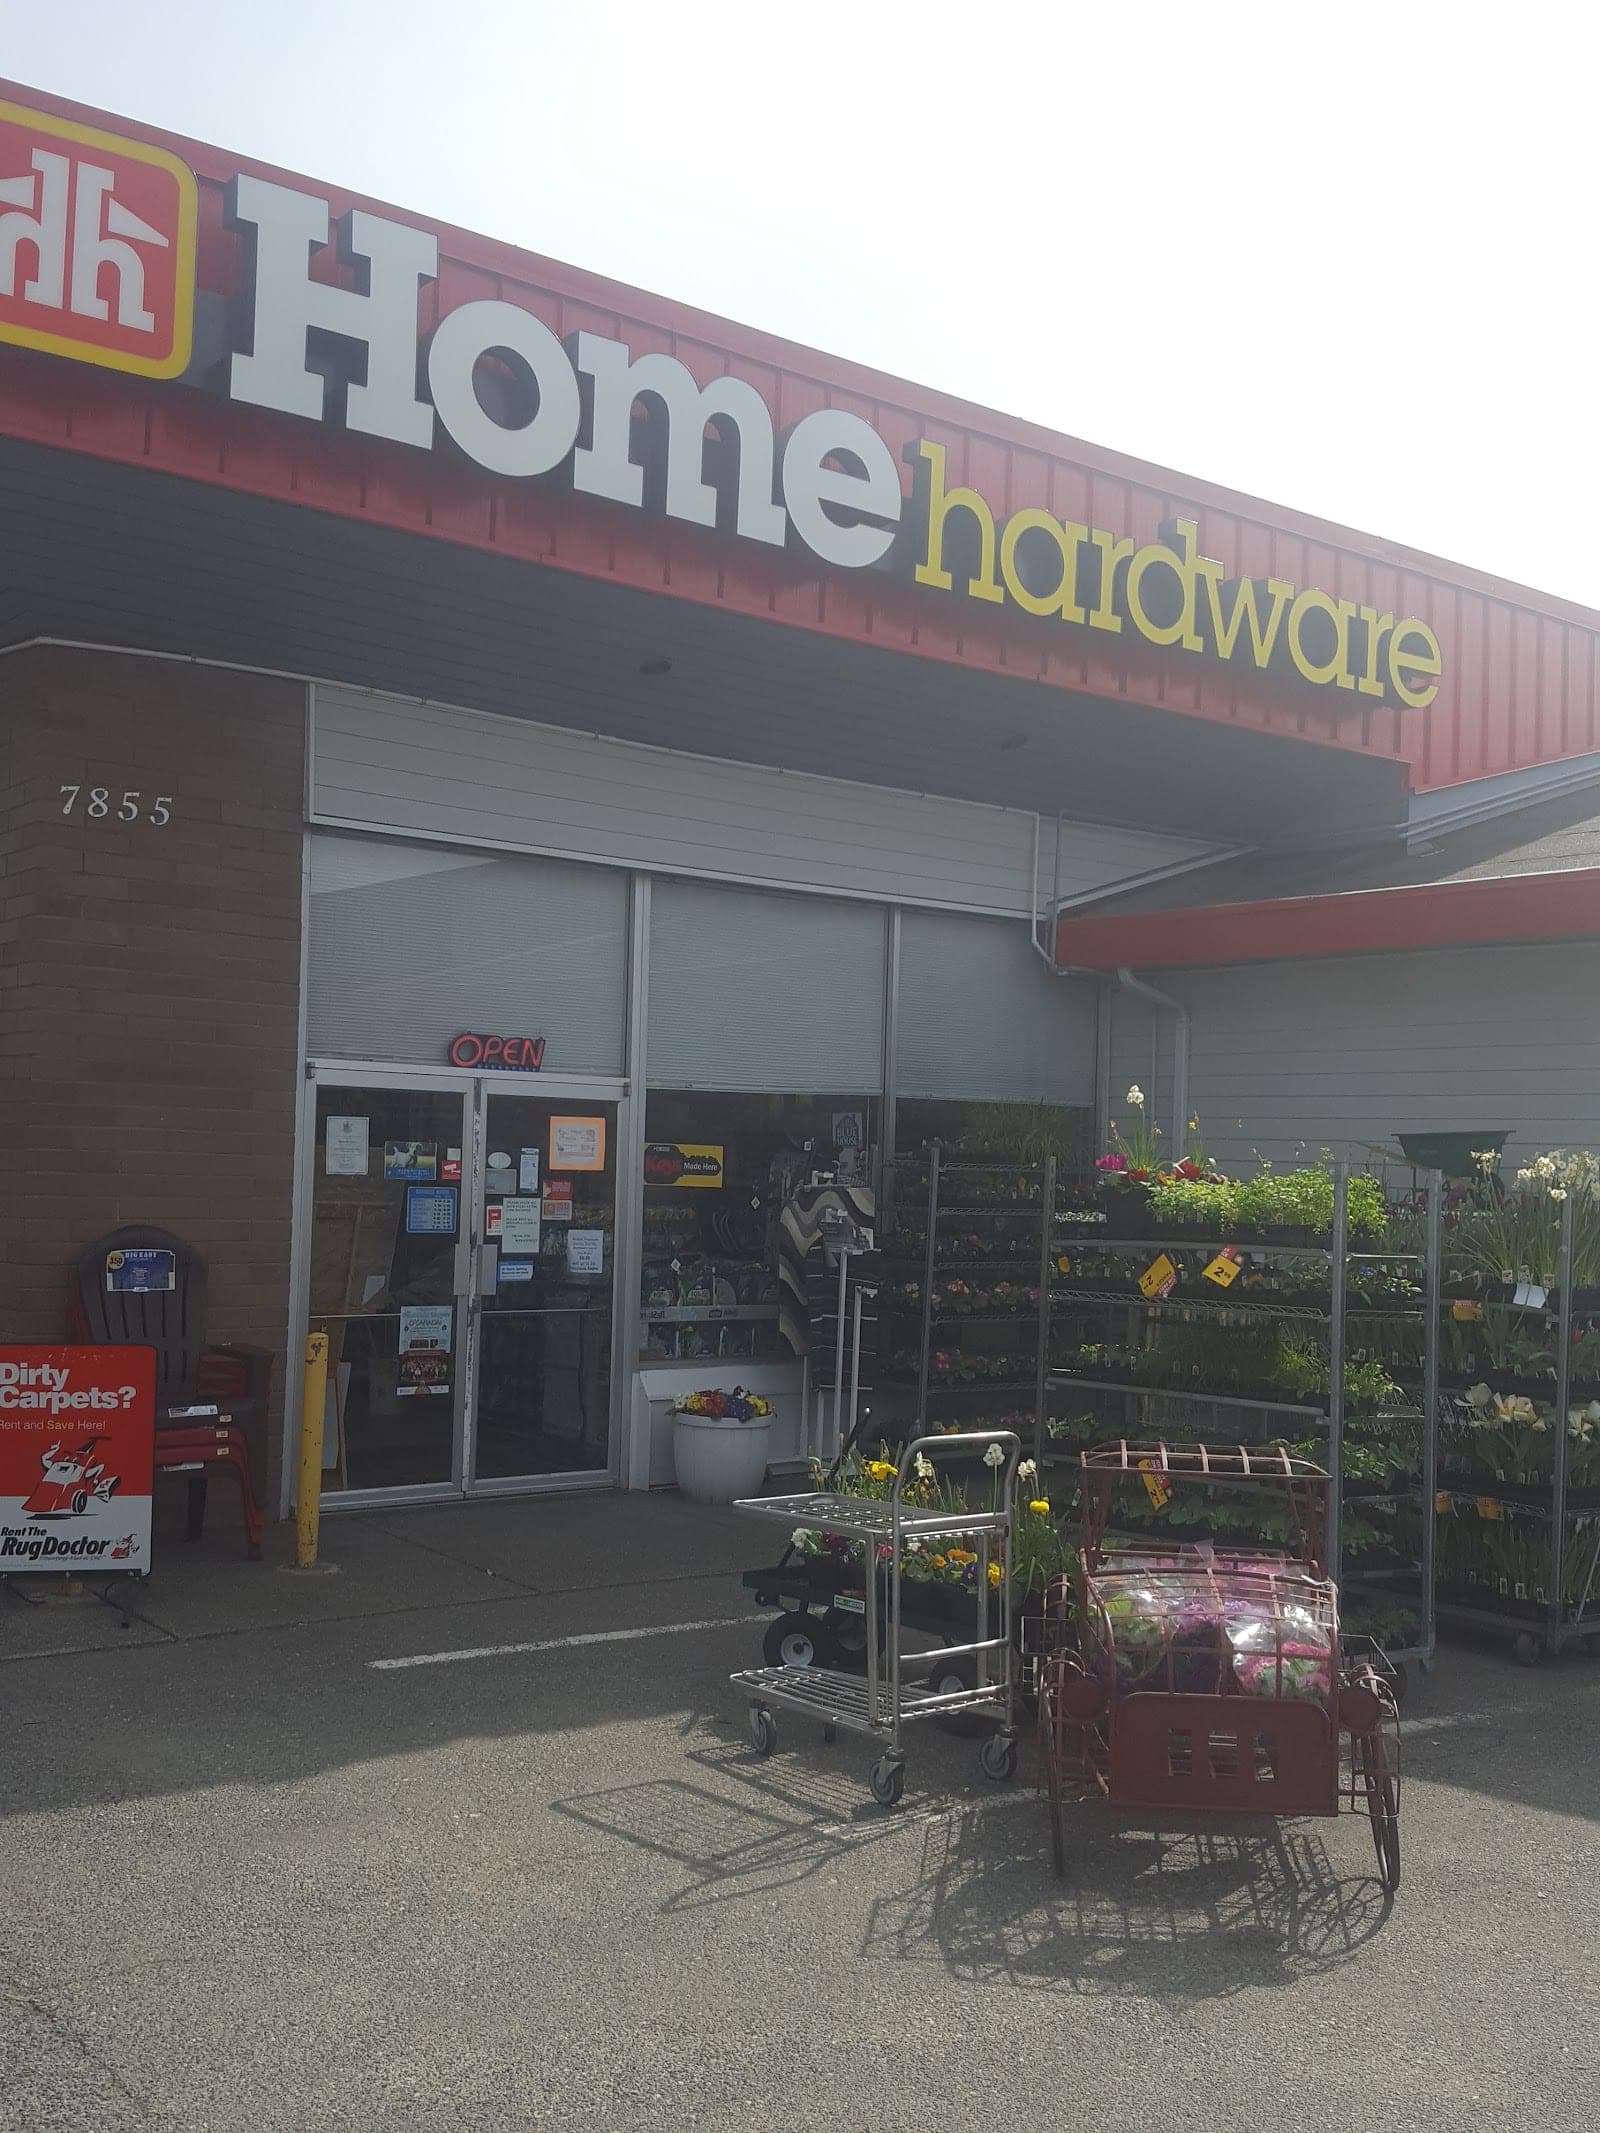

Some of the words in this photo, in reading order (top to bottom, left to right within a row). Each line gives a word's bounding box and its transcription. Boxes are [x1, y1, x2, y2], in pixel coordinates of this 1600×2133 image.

[229, 172, 903, 568] Home
[914, 438, 1443, 709] hardware
[59, 784, 173, 826] 7855
[451, 1034, 545, 1068] OPEN
[683, 1161, 702, 1170] Made
[702, 1162, 718, 1171] Here
[0, 1362, 70, 1391] Dirty
[0, 1385, 138, 1415] Carpets?
[23, 1420, 44, 1431] and
[47, 1420, 75, 1431] Save
[78, 1419, 106, 1430] Here!
[1, 1526, 27, 1537] Rent
[28, 1526, 48, 1537] The
